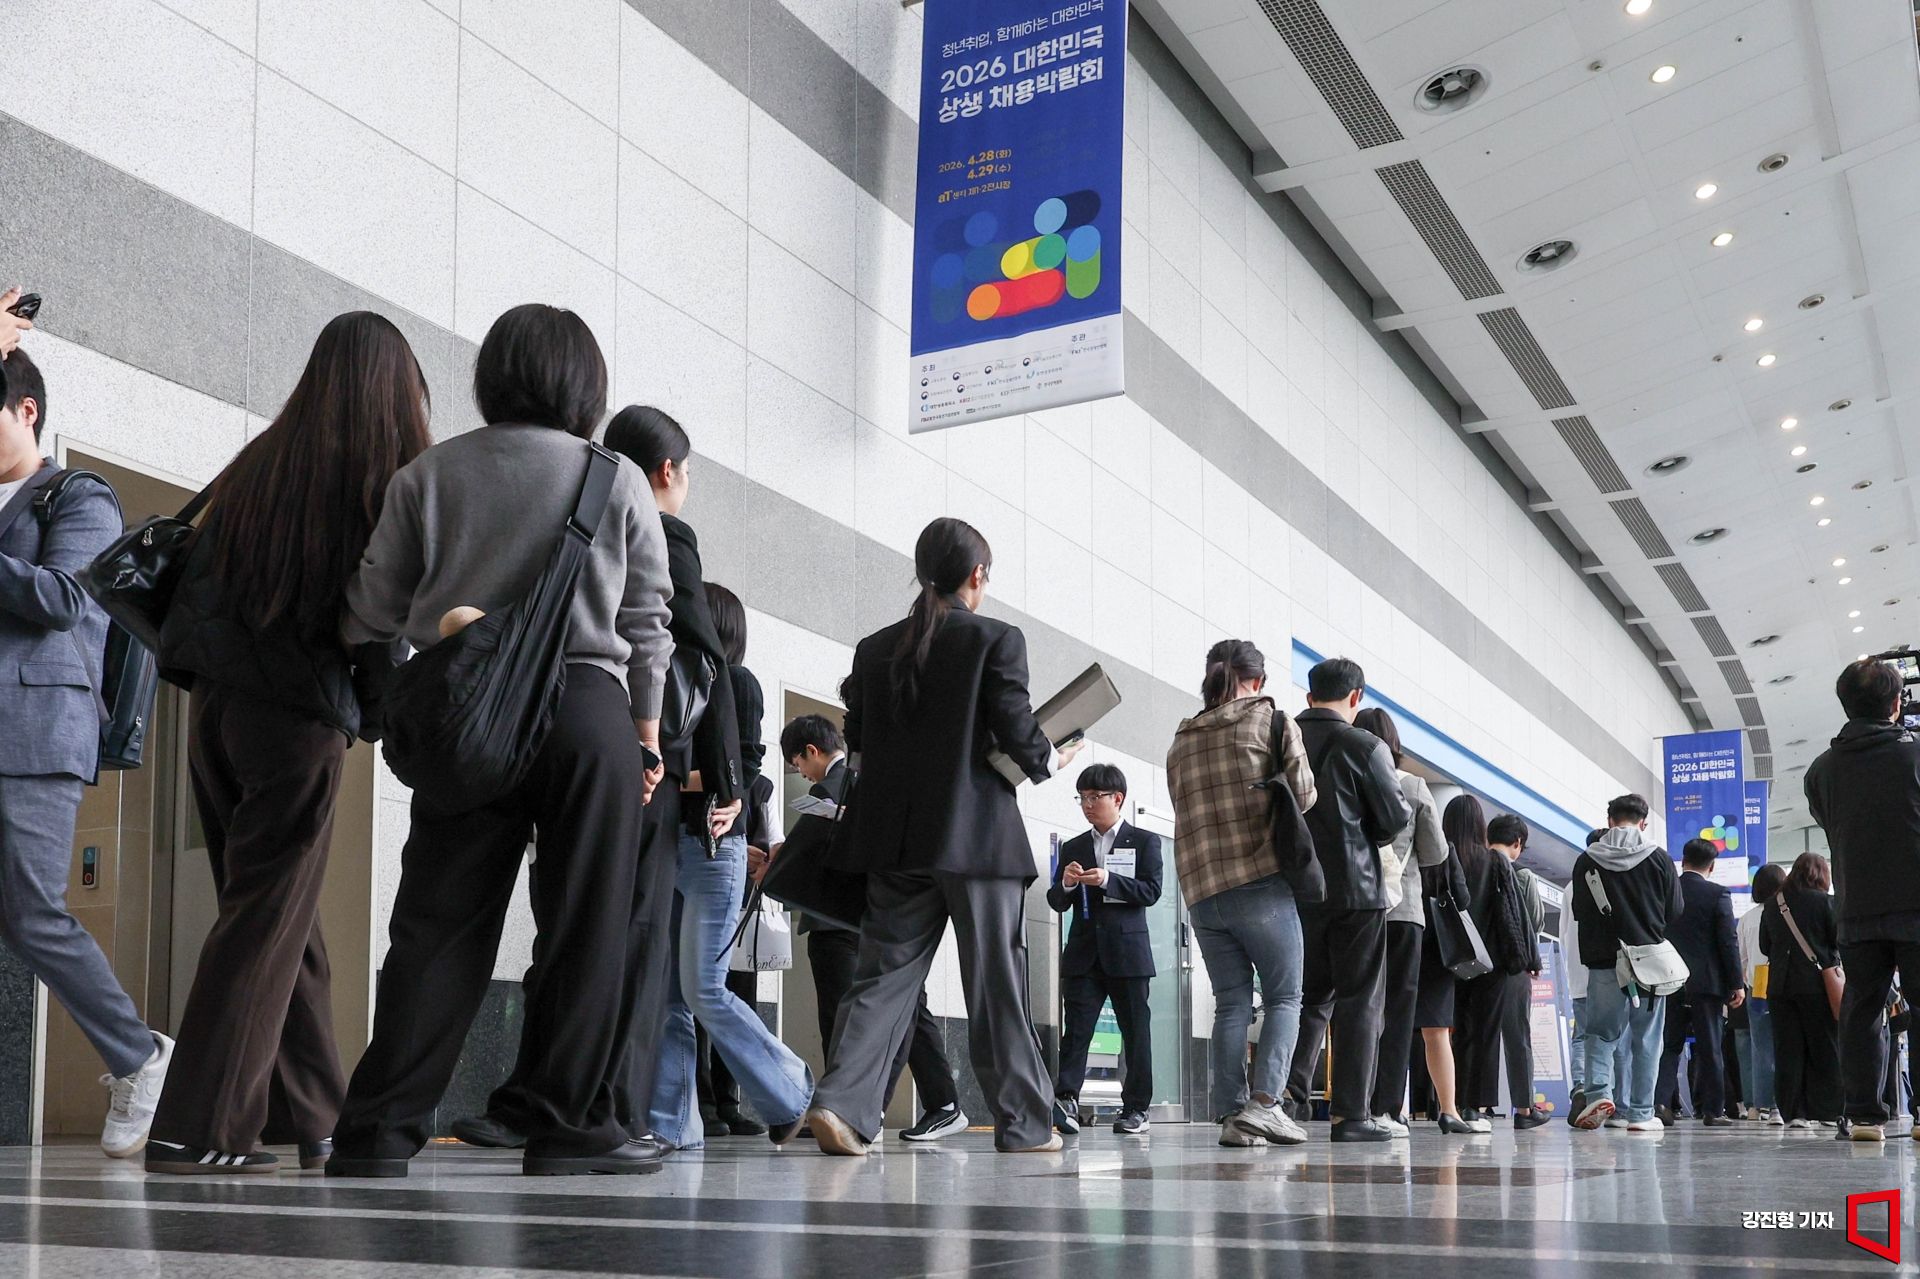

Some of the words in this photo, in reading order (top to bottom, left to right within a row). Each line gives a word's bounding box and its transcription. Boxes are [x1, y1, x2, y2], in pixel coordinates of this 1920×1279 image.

[940, 56, 1007, 93] 2026
[1013, 25, 1104, 74] 대한민국
[942, 32, 993, 58] 청년취업,
[997, 17, 1049, 42] 함께하는
[1052, 0, 1105, 25] 대한민국
[938, 91, 983, 124] 상생
[988, 57, 1104, 109] 채용박람회
[1672, 763, 1698, 773] 2026
